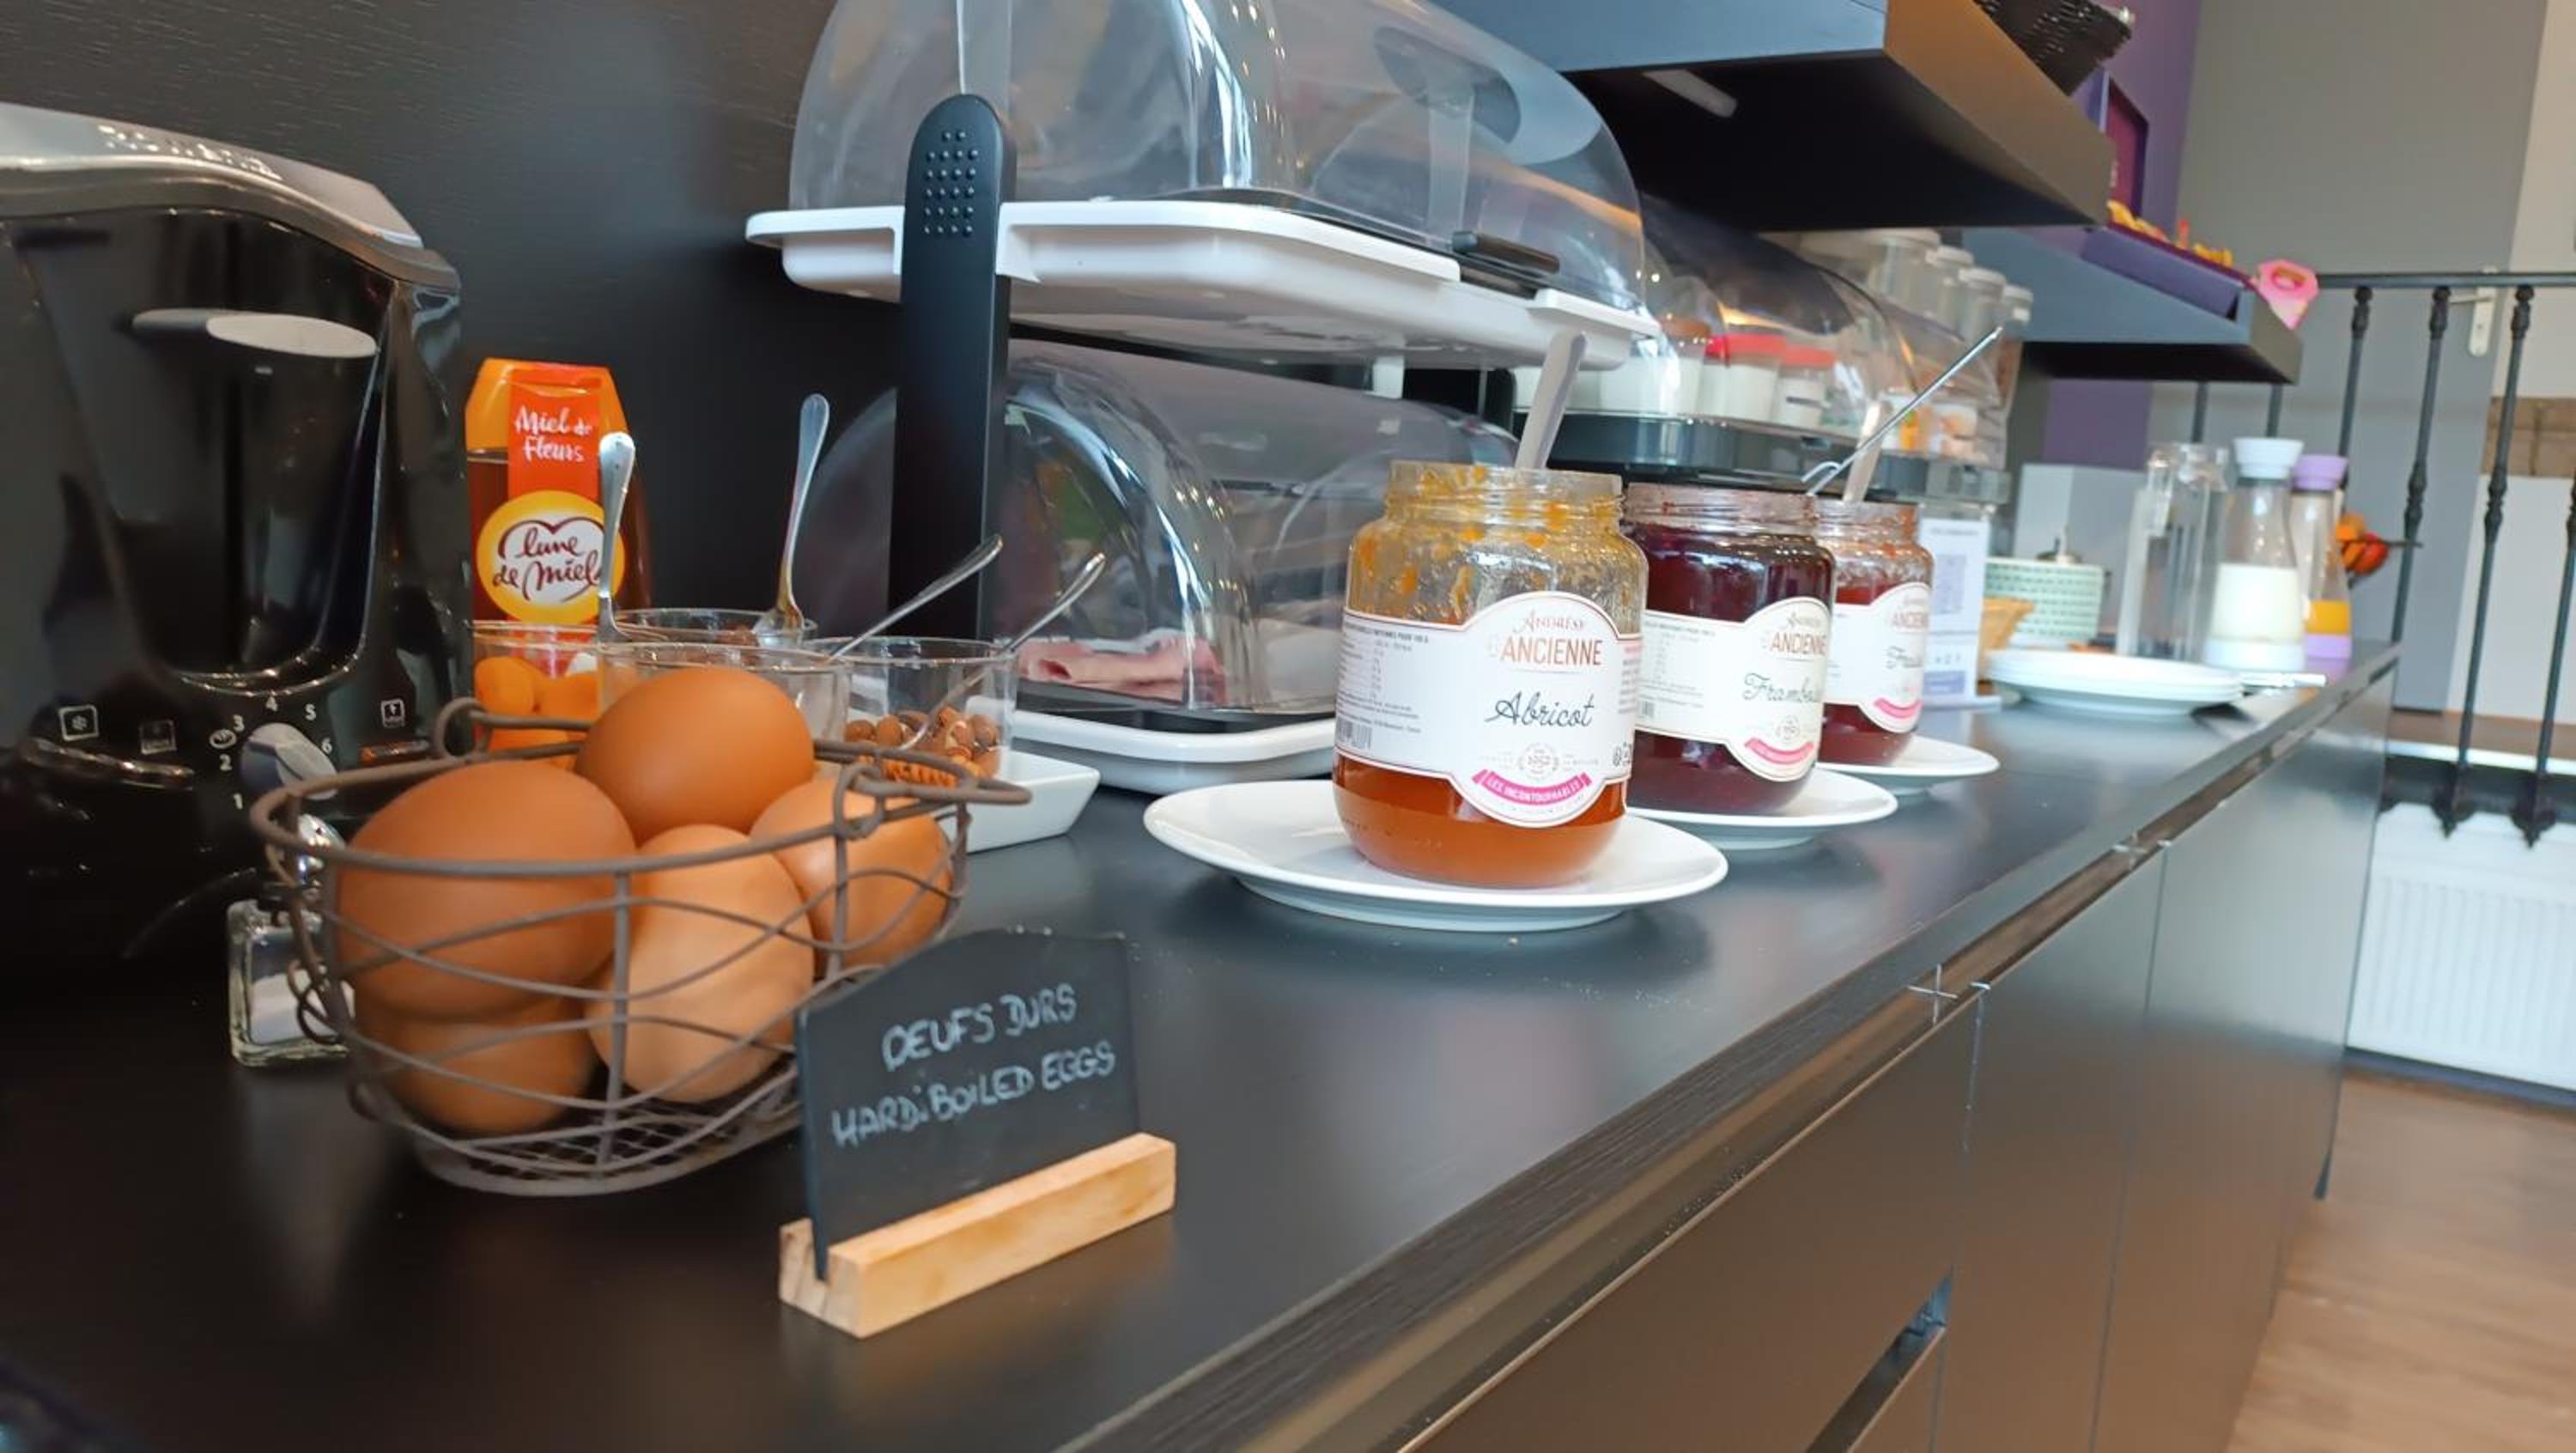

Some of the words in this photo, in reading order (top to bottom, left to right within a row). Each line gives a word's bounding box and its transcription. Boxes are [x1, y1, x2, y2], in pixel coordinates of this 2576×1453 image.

[515, 406, 569, 435] Miel
[523, 435, 585, 463] Fleurs
[492, 565, 519, 587] de
[265, 696, 278, 712] 4
[305, 703, 317, 720] 5
[1485, 691, 1595, 728] Abricot
[233, 714, 245, 733] 3
[321, 738, 332, 754] 6
[219, 754, 233, 771] 2
[233, 793, 243, 810] 1
[999, 982, 1078, 1037] DURS
[1041, 1039, 1117, 1091] EGGS
